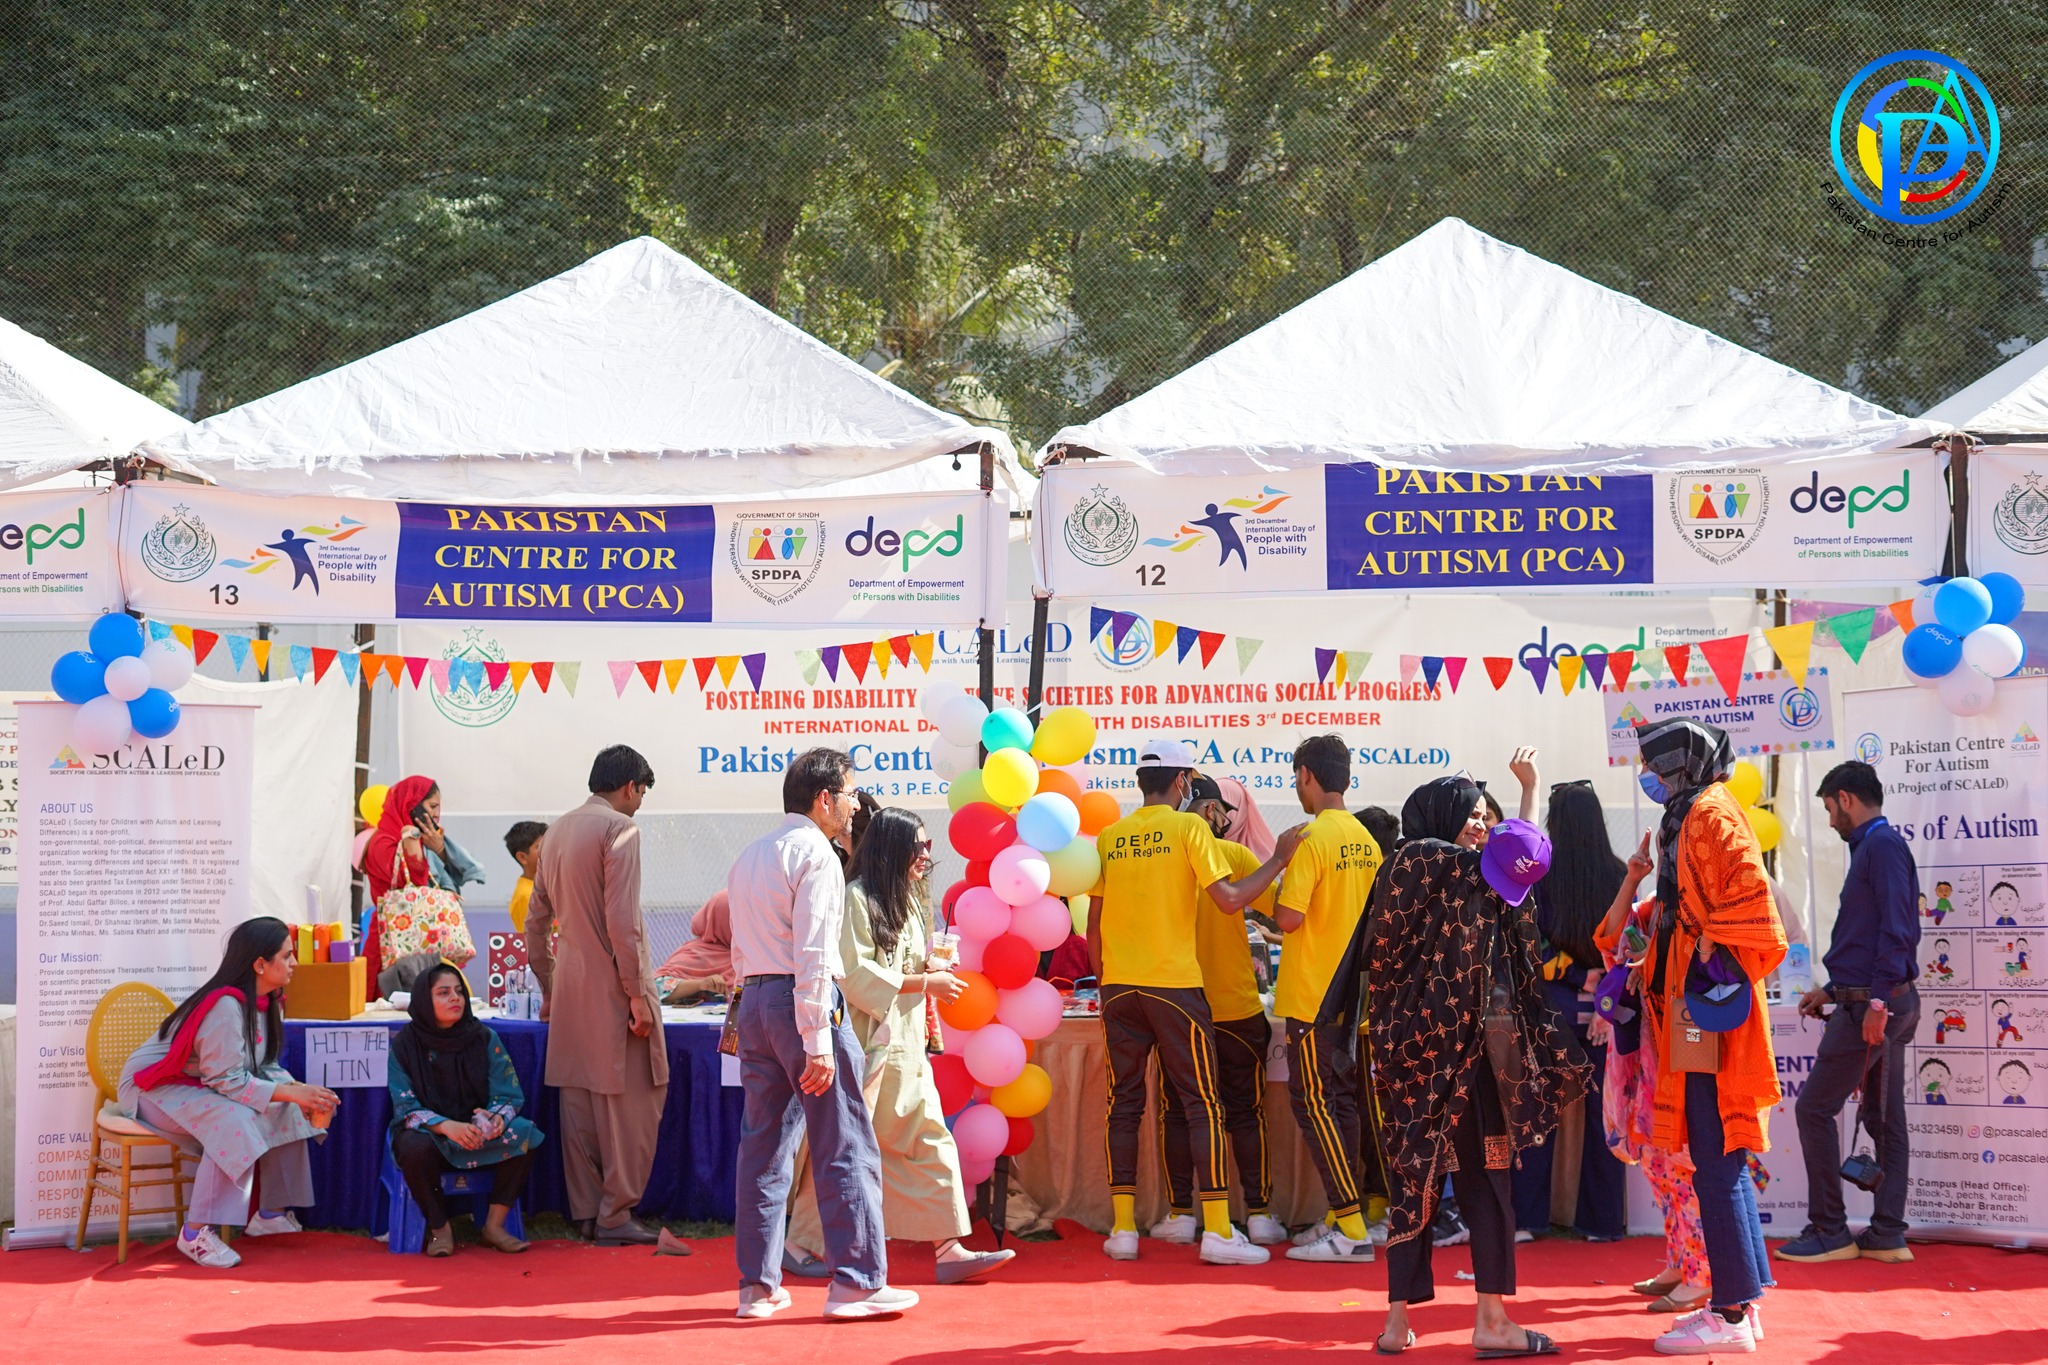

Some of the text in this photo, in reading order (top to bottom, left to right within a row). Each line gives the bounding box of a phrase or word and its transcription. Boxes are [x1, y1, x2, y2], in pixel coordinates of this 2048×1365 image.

[1790, 469, 1910, 529] depd
[444, 508, 668, 533] PAKISTAN
[1364, 506, 1618, 536] CENTRE FOR
[0, 508, 84, 565] epd
[1245, 525, 1290, 533] International
[1292, 525, 1307, 534] Day
[1694, 527, 1745, 539] SPDPA
[845, 514, 963, 572] depd
[1246, 533, 1307, 545] People with
[1794, 536, 1913, 546] Department of Empowerment
[318, 552, 362, 560] International
[363, 554, 378, 562] Day
[434, 544, 678, 570] CENTRE FOR
[1258, 545, 1307, 556] Disability
[1798, 548, 1908, 558] of Persons with Disabilities
[318, 561, 377, 572] People with
[729, 521, 826, 606] SINDH PERSONS WITH DISABILITIES PROTECTION AUTHORITY
[1356, 546, 1625, 579] AUTISM (PCA)
[22, 572, 88, 581] of Empowerment
[330, 572, 376, 584] Disability
[751, 569, 802, 581] SPDPA
[1136, 564, 1166, 586] 12
[23, 584, 84, 593] with Disabilities
[849, 578, 965, 589] Department of Empowerment
[209, 584, 240, 605] 13
[424, 582, 684, 615] AUTISM (PCA)
[852, 592, 960, 601] of Persons with Disabilities
[1655, 627, 1728, 636] Department of
[996, 657, 1030, 665] Learning
[705, 689, 806, 711] FOSTERING
[813, 688, 918, 709] DISABILITY
[1022, 686, 1113, 706] SCIETIES
[1121, 685, 1162, 705] FOR
[1165, 683, 1268, 704] ADVANCING
[1275, 682, 1337, 703] SOCIAL
[1344, 681, 1442, 702] PROGRESS
[1654, 693, 1774, 714] PAKISTAN CENTRE
[1132, 712, 1381, 729] DISABILITIES 3rd DECEMBER
[1704, 711, 1755, 724] AUTISM
[764, 719, 910, 734] INTERNATIONAL
[1890, 736, 2005, 756] Pakistan Centre
[2011, 743, 2040, 751] SCALeD
[698, 744, 932, 773] Pakist Cent
[1232, 747, 1258, 768] (A
[1359, 748, 1450, 768] SCALeD)
[1905, 756, 1990, 774] For Autism
[1254, 775, 1283, 788] 343
[1884, 777, 2008, 796] (A Project of SCALeD)
[891, 783, 900, 796] 3
[41, 804, 93, 814] ABOUT US
[74, 819, 97, 828] Society
[99, 818, 109, 826] for
[111, 818, 138, 826] Children
[140, 818, 153, 826] with
[156, 818, 177, 826] Autism
[179, 818, 191, 826] and
[193, 818, 221, 827] Learning
[1923, 814, 1949, 840] of
[1954, 812, 2040, 840] Autism
[1107, 845, 1171, 861] Khi Region
[39, 952, 102, 963] Our Mission:
[66, 968, 115, 976] comprehensive
[118, 966, 154, 975] Therapeutic
[313, 1031, 387, 1054] HIT THE
[40, 1046, 85, 1057] Our Visio
[336, 1058, 371, 1081] TIN
[38, 1133, 65, 1145] CORE
[1908, 1124, 2048, 1139] 34323459) @pcascaled
[38, 1148, 120, 1164] COMPASION
[1908, 1148, 1979, 1163] forautism.org
[1918, 1178, 2030, 1193] Campus (Head Office):
[1991, 1192, 2027, 1202] Karachi
[1907, 1198, 2018, 1212] listan-e-Johar Branch:
[1908, 1208, 1988, 1221] Gulistan-e-Johar,
[1992, 1213, 2028, 1223] Karachi
